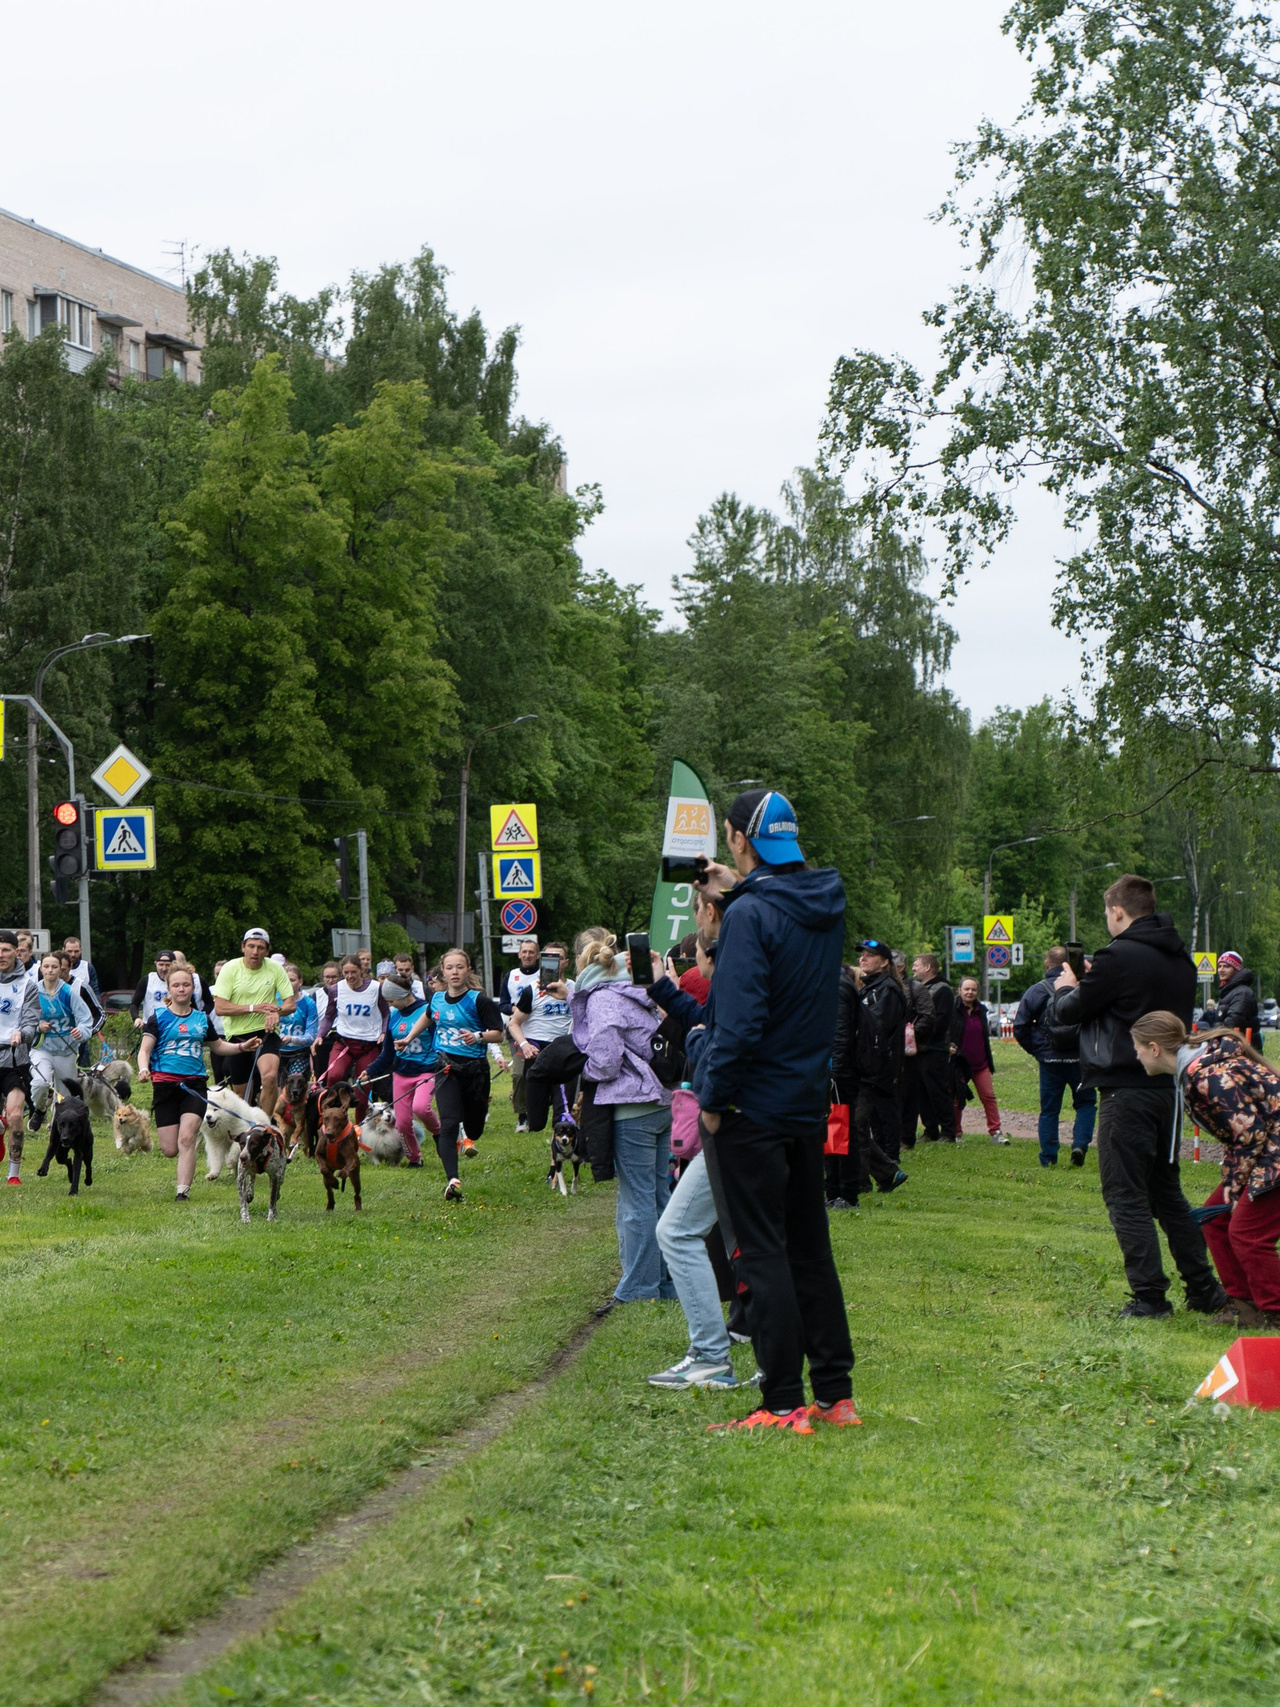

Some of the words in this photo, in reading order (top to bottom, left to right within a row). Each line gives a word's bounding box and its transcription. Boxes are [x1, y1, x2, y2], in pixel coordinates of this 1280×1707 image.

[769, 821, 797, 834] ORLANDO
[345, 1004, 371, 1016] 172
[544, 1003, 570, 1015] 217
[437, 1027, 471, 1046] 32
